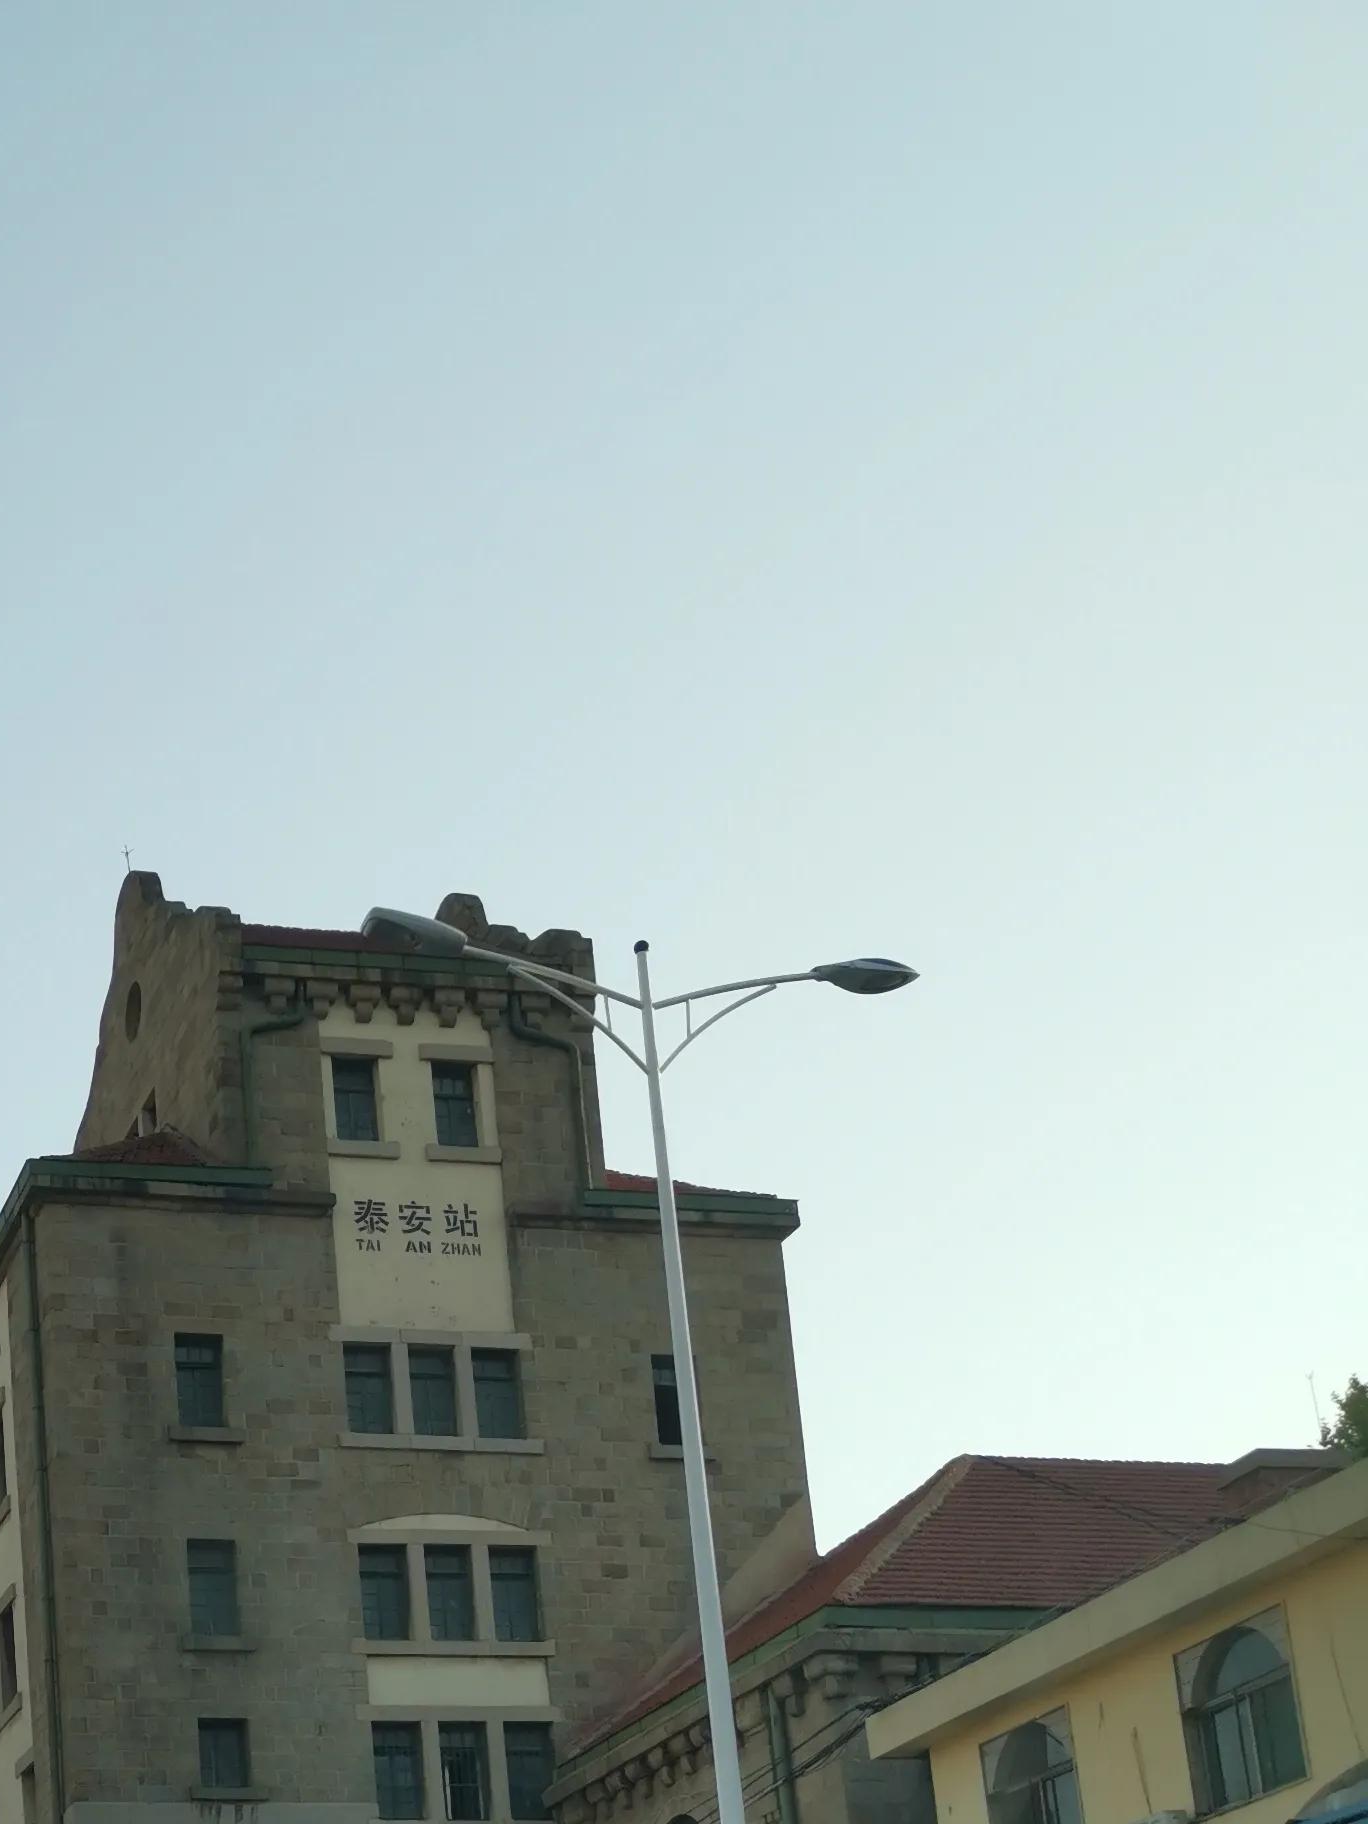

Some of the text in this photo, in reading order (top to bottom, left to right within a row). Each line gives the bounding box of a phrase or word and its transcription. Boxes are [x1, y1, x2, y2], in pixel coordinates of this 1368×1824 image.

[353, 1198, 480, 1238] 泰安站
[355, 1238, 482, 1257] TAI AN ZHAN
